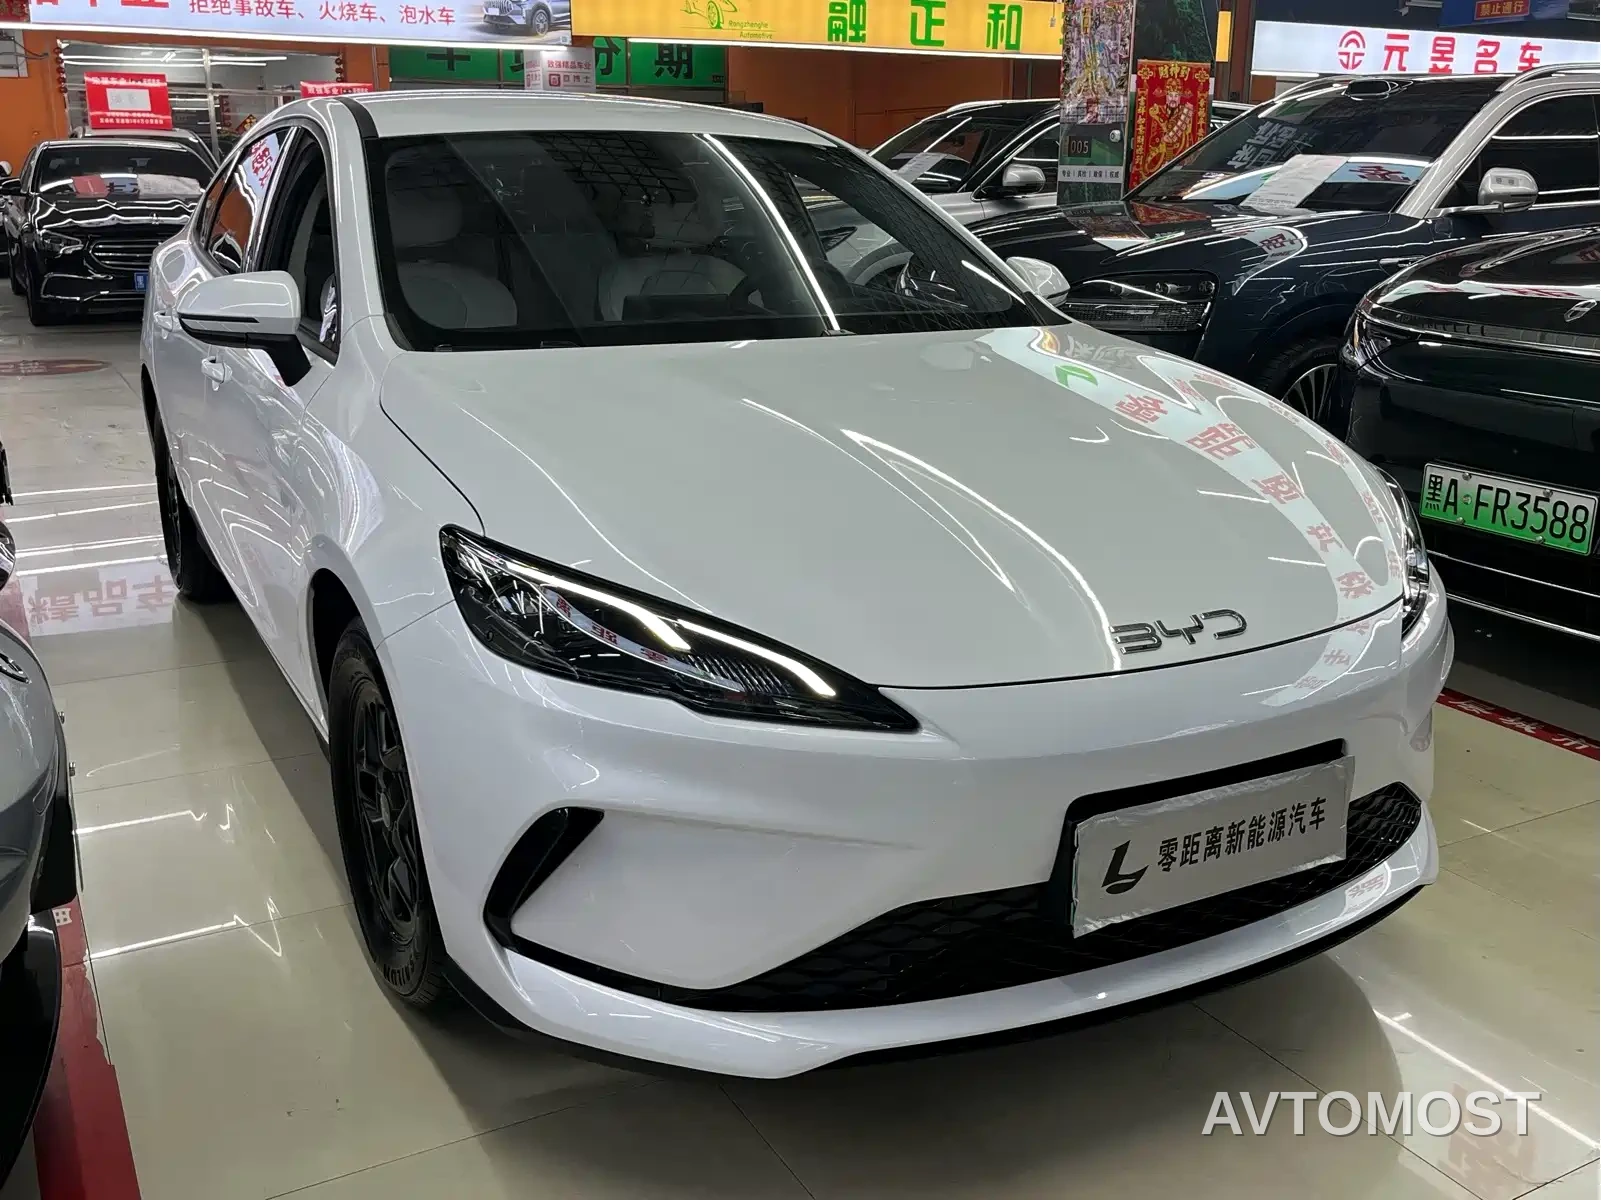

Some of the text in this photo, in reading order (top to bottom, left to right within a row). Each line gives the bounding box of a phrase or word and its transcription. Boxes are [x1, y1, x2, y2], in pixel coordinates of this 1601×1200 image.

[827, 0, 1064, 50] 融正和
[1480, 0, 1524, 16] 禁止通行
[1070, 140, 1089, 154] 005
[1108, 608, 1247, 655] BYD
[1157, 796, 1327, 873] 零距离新能源汽车
